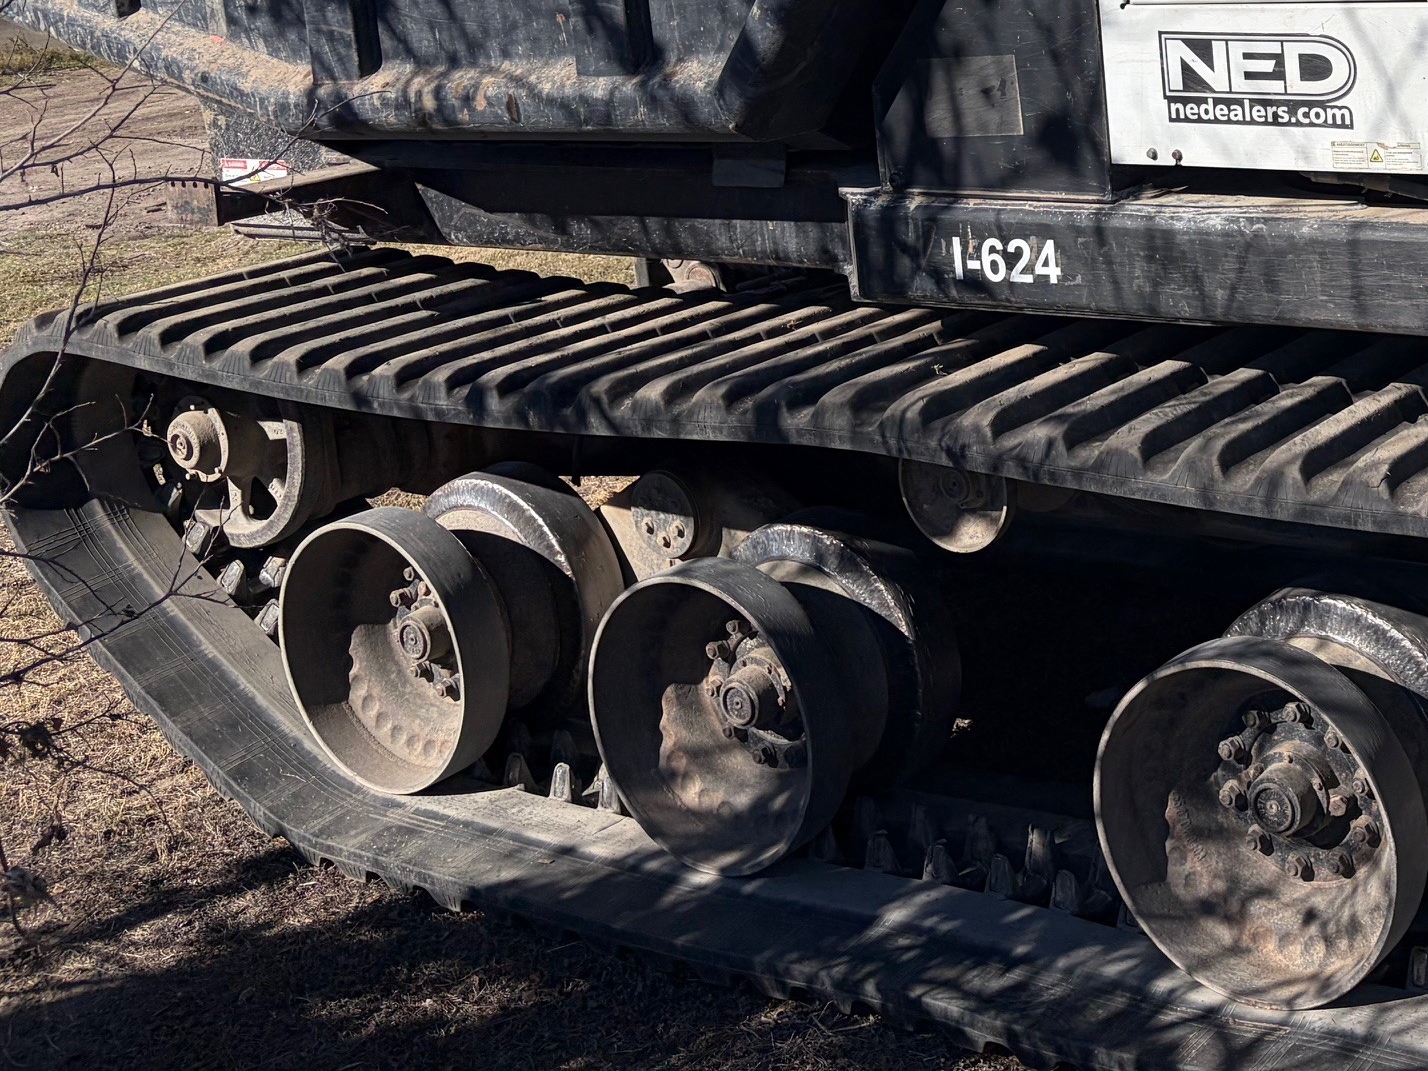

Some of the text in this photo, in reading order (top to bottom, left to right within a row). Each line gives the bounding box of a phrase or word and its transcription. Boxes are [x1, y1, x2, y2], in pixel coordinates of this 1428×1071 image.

[1165, 38, 1352, 95] NED
[1170, 97, 1351, 125] nedealers.com
[952, 236, 1062, 284] I-624
